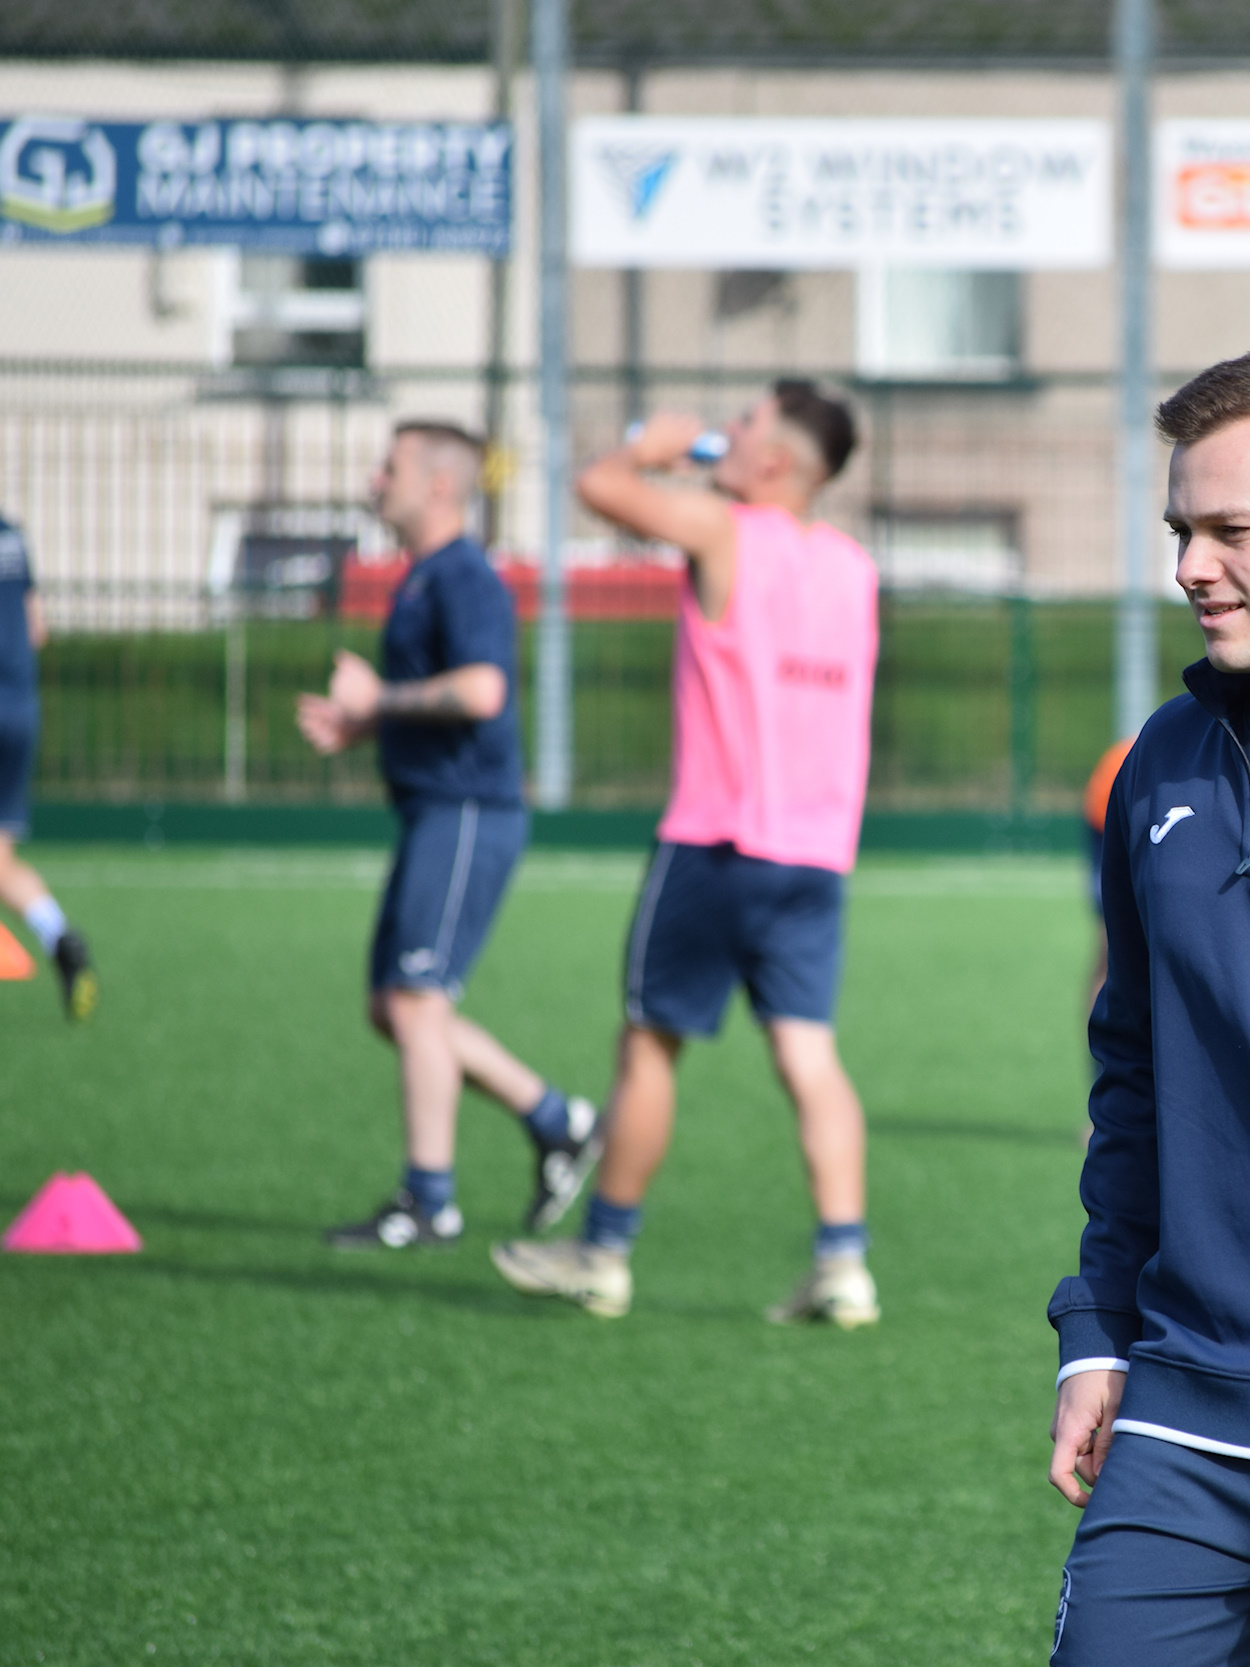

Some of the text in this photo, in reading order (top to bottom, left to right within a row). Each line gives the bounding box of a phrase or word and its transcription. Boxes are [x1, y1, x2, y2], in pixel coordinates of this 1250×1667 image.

[138, 122, 511, 176] GJ PROPERTY
[813, 145, 1092, 187] WINDOW
[137, 174, 507, 220] MAINTENANCE
[760, 192, 1023, 239] SYSTEMS
